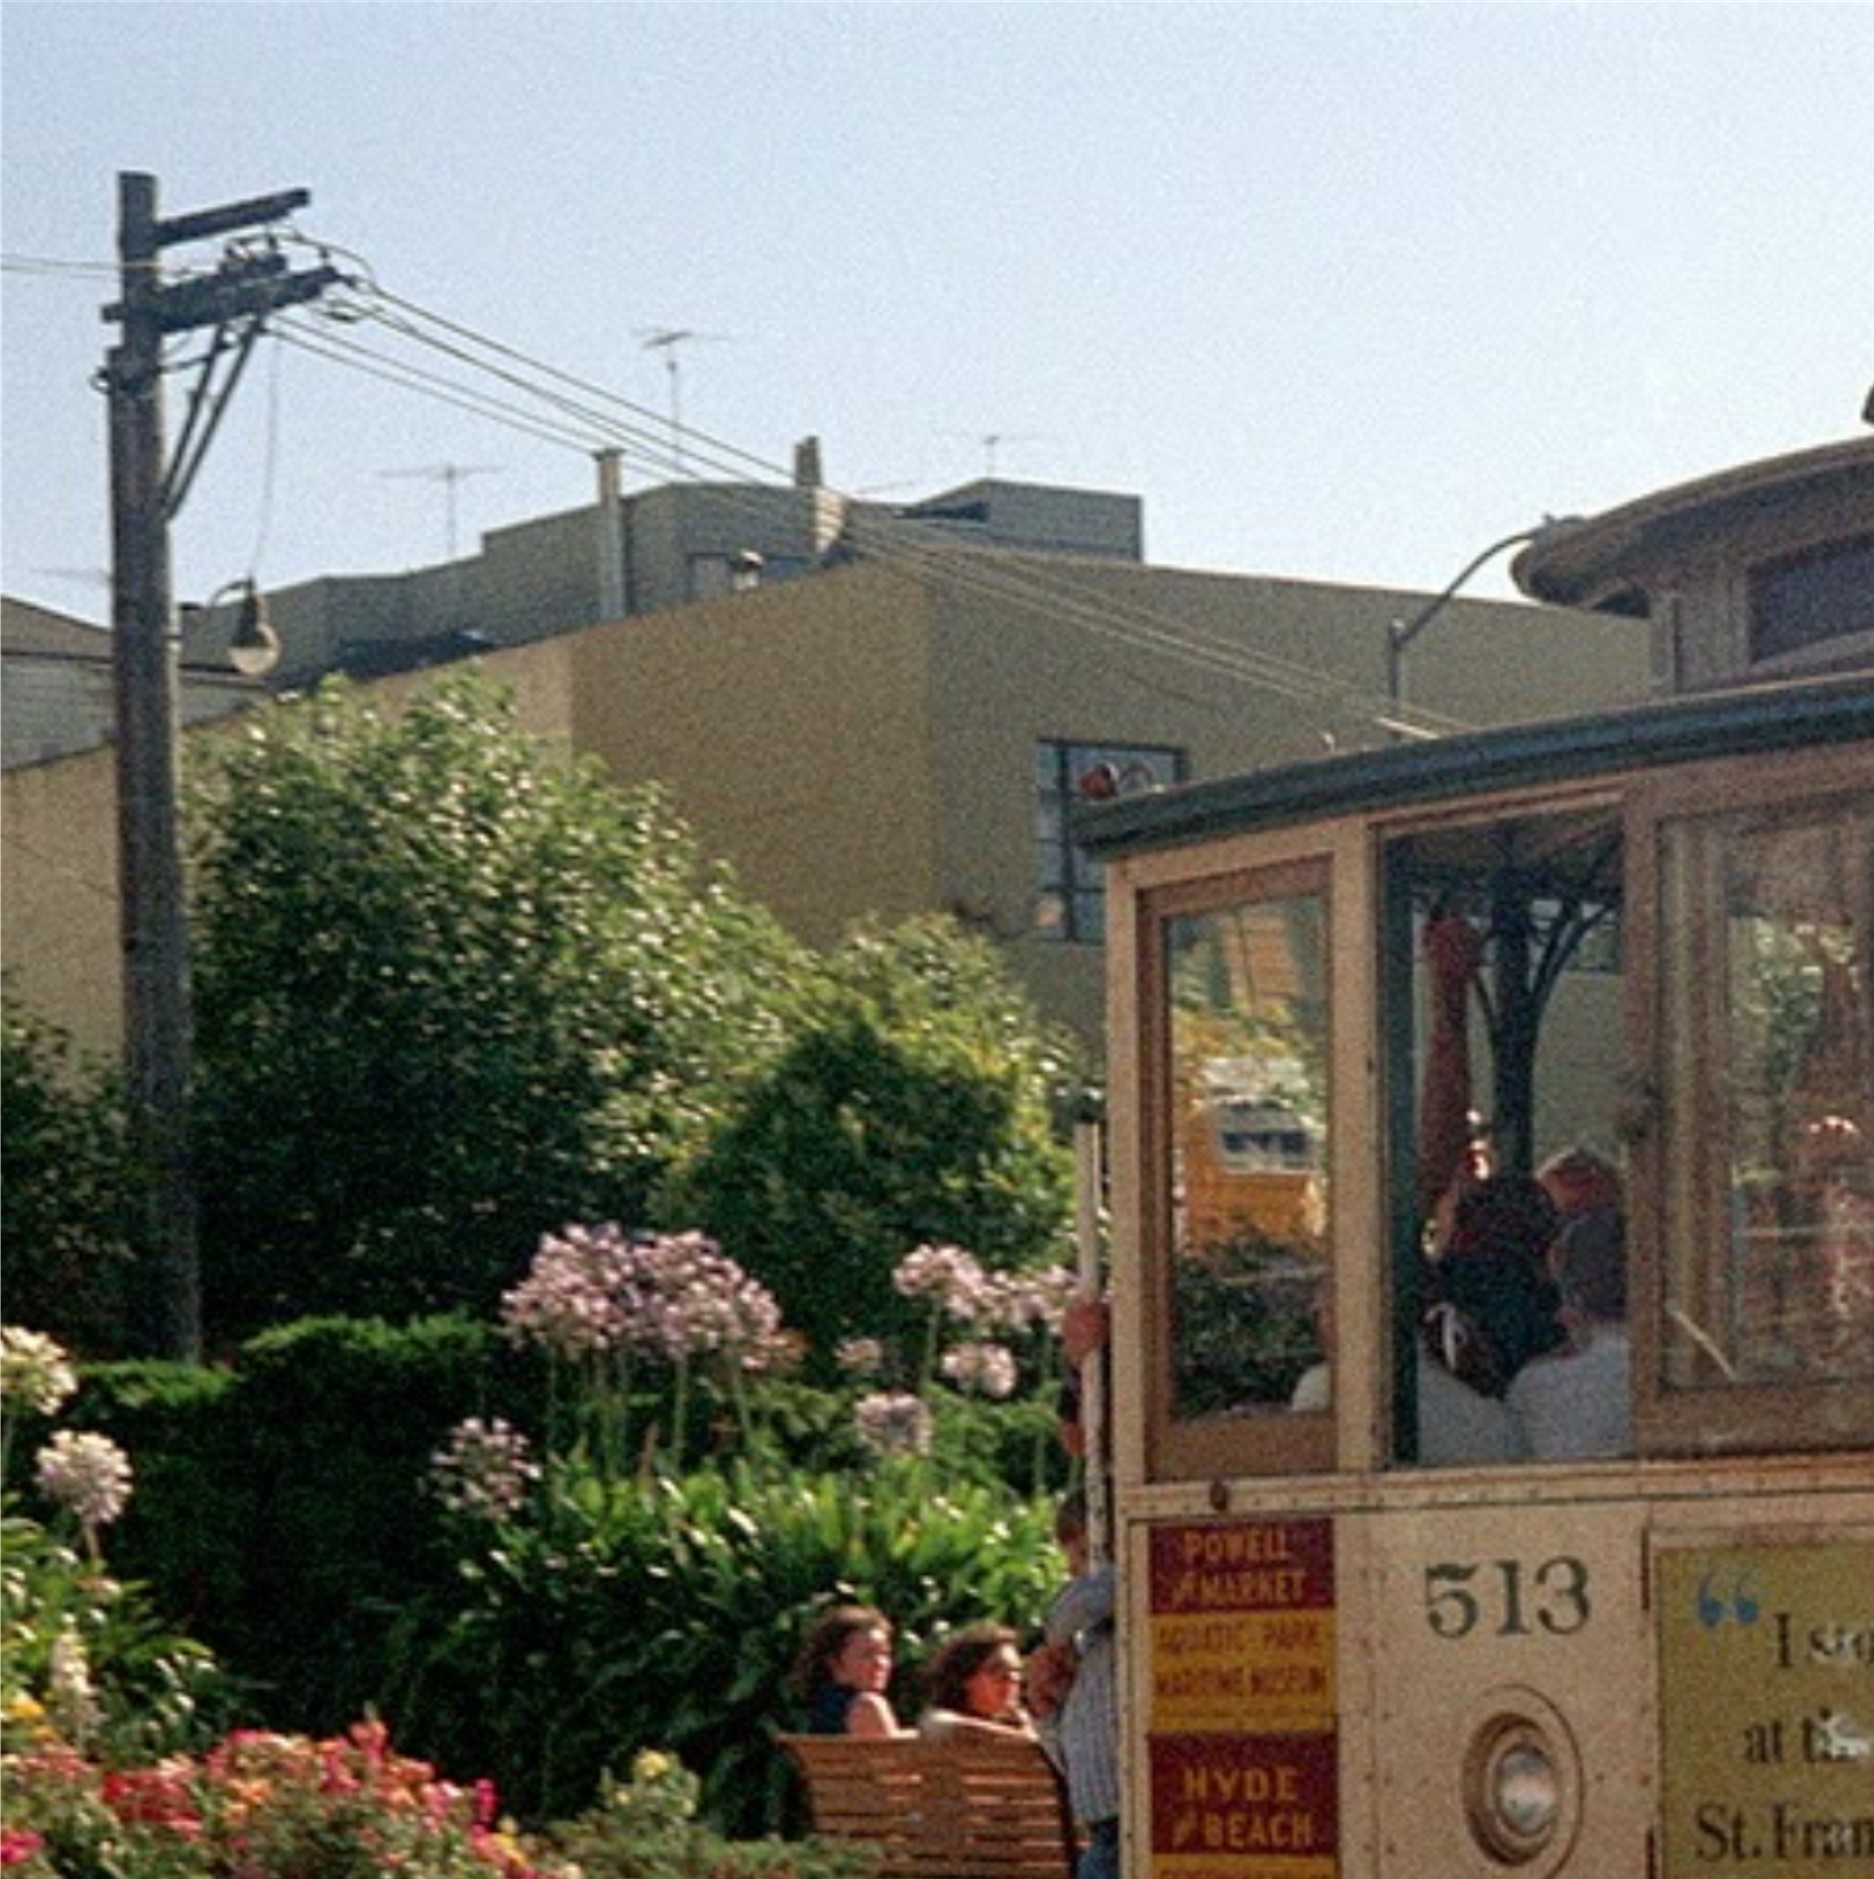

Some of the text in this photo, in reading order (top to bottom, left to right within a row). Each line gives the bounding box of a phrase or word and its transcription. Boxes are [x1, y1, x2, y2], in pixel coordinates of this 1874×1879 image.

[1425, 1556, 1590, 1639] 513
[1743, 1716, 1783, 1765] at
[1183, 1767, 1299, 1802] HYDE
[1204, 1812, 1314, 1848] BEACH
